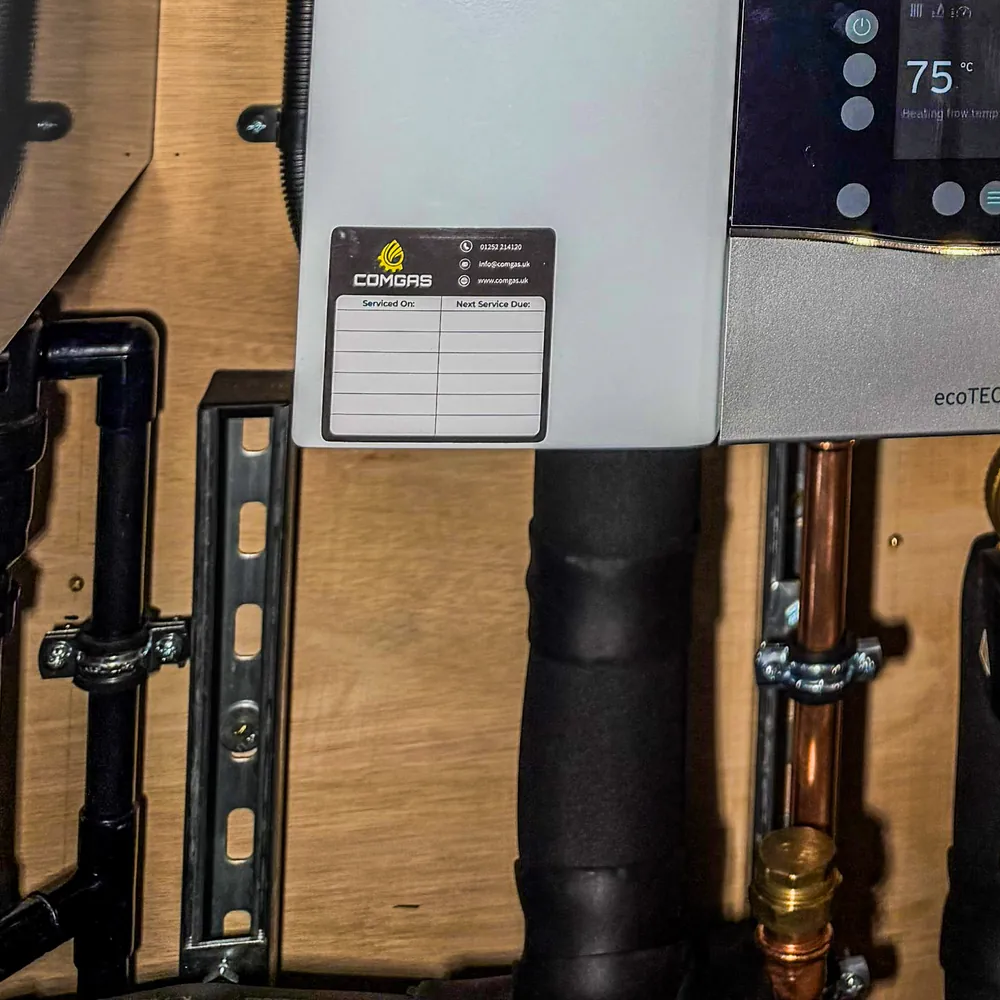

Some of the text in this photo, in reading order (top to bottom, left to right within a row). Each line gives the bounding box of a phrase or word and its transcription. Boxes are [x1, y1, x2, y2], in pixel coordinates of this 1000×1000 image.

[906, 60, 974, 94] 75 °C
[901, 107, 944, 122] Heating
[971, 108, 1000, 121] temp
[479, 243, 522, 251] 01252 214120
[478, 260, 530, 270] info@comgas.uk
[353, 273, 433, 288] COMGAS
[477, 277, 529, 286] www.comgas.uk
[456, 300, 476, 308] Next
